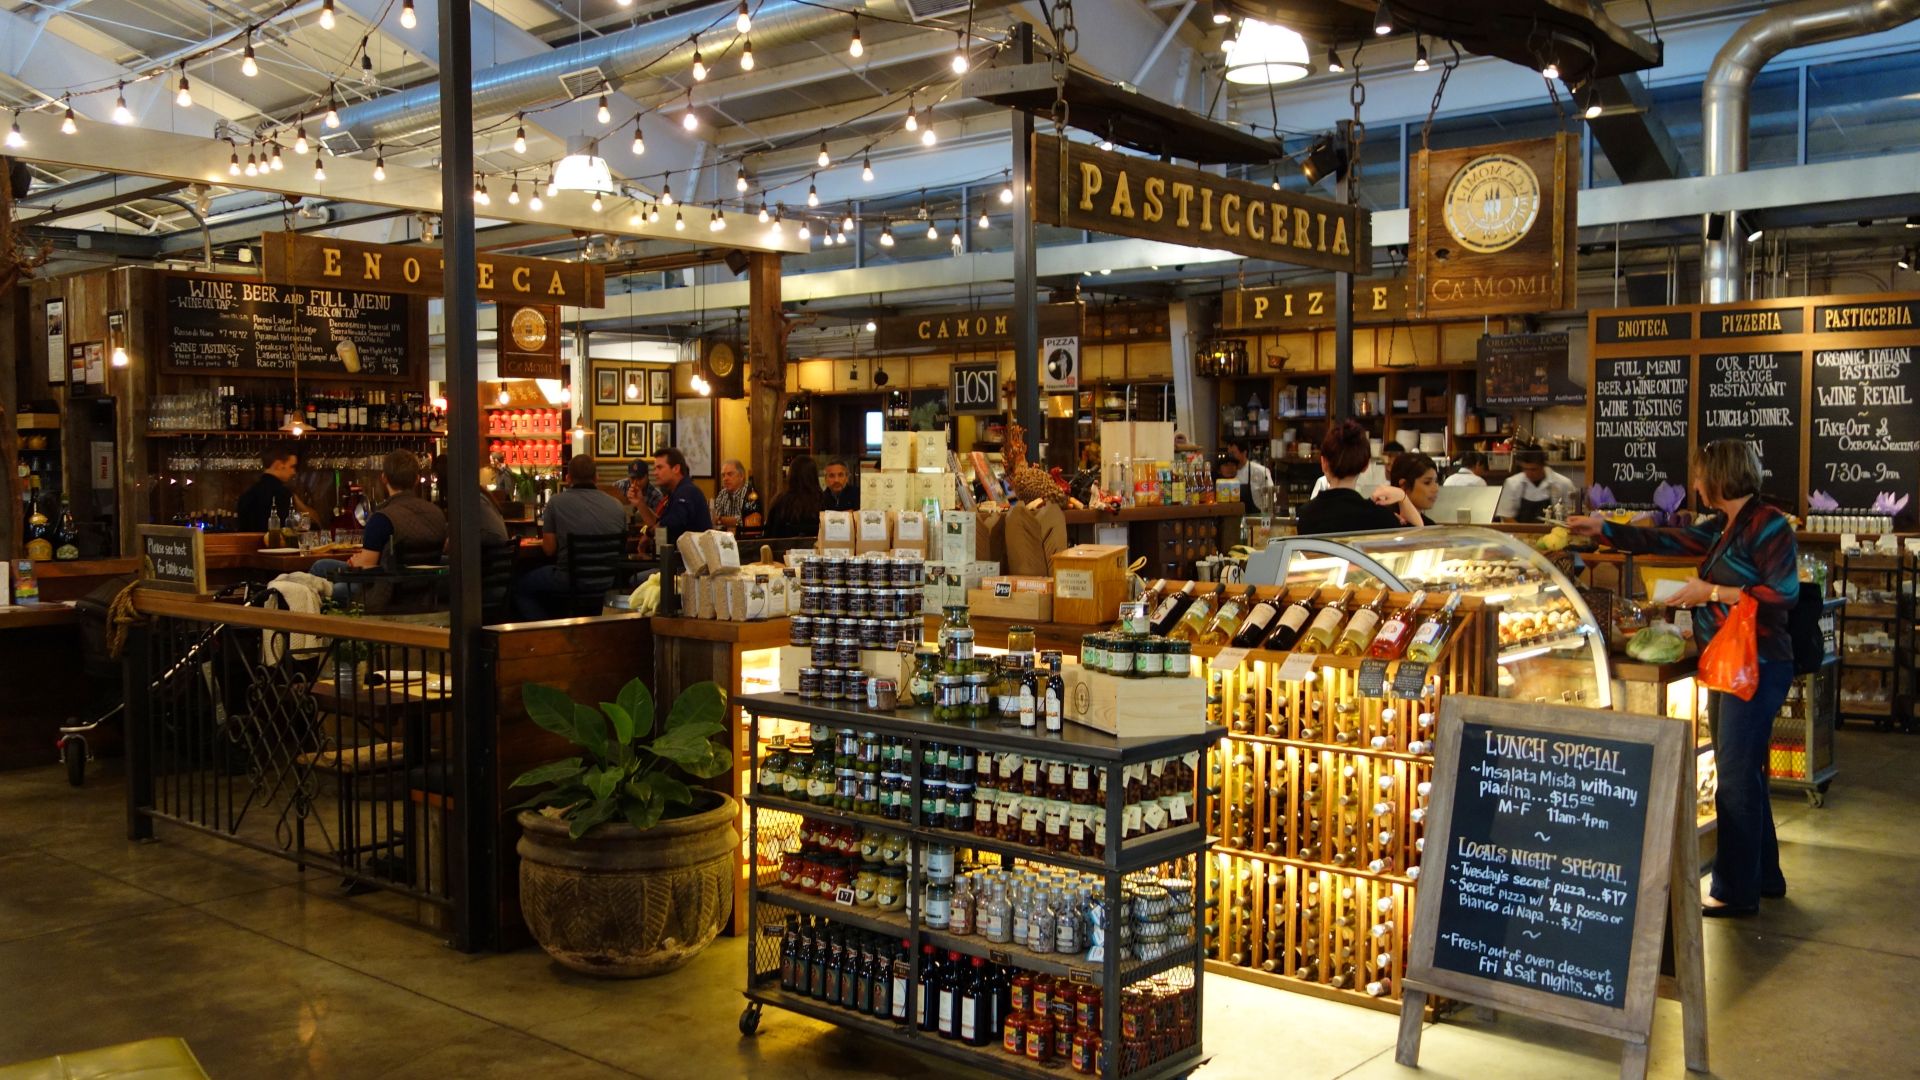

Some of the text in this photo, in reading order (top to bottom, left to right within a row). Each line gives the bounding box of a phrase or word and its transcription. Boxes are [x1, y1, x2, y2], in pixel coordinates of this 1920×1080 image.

[1078, 162, 1351, 256] PASTICCERIA
[322, 248, 565, 296] ENOECA
[178, 296, 231, 310] WINE ON TAP
[242, 284, 280, 303] BEER
[283, 293, 305, 305] AND
[310, 290, 347, 308] FULL
[353, 293, 391, 311] MENU
[1254, 286, 1408, 319] PIZE
[306, 306, 360, 319] BEER ON TAP
[1721, 312, 1782, 333] PIZZERIA
[1824, 306, 1912, 329] PASTICCERIA
[918, 315, 1007, 340] CAMOM
[1617, 319, 1669, 339] ENOTECA
[174, 342, 237, 354] WINE TASTINGS
[1046, 338, 1075, 347] PIZZA
[1538, 335, 1568, 345] LOCA
[1715, 354, 1778, 371] OUR FULL
[1816, 347, 1912, 367] ORGANIC ITALIAN
[1614, 359, 1681, 376] FULL MENU
[1724, 369, 1772, 383] SERVICE
[1840, 362, 1901, 380] PASTRIES
[954, 369, 998, 405] HOST
[1597, 378, 1688, 396] BEER & WINE ON TAP
[1709, 381, 1787, 398] RESTAURANT
[1817, 385, 1913, 406] WINE RETAIL
[1599, 398, 1682, 417] WINE TASTING
[1706, 407, 1794, 427] LUNCH & DINNER
[1595, 420, 1688, 438] ITALIAN BREAKFAST
[1875, 417, 1889, 437] &
[1624, 441, 1657, 458] OPEN
[147, 538, 187, 556] Please see host
[157, 558, 194, 577] for table seatin
[1485, 730, 1626, 776] LUNCH SPECIAL
[1481, 760, 1638, 807] Insalata Mista with any
[1498, 798, 1609, 830] M-F 11am-4pm
[1458, 836, 1508, 864] LOCALS
[1561, 856, 1627, 886] SPECIAL
[1460, 861, 1509, 885] Tuesday's
[1513, 874, 1551, 890] secret
[1458, 877, 1497, 897] Secret
[1499, 888, 1526, 905] pizza
[1529, 895, 1544, 908] w/
[1576, 903, 1609, 923] Rosso
[1609, 914, 1624, 925] or
[1459, 894, 1499, 913] Bianco
[1502, 902, 1514, 916] di
[1450, 932, 1613, 984] Fresh out of oven dessert
[1479, 956, 1499, 973] Fri
[1503, 961, 1513, 977] &
[1514, 964, 1538, 984] Sat
